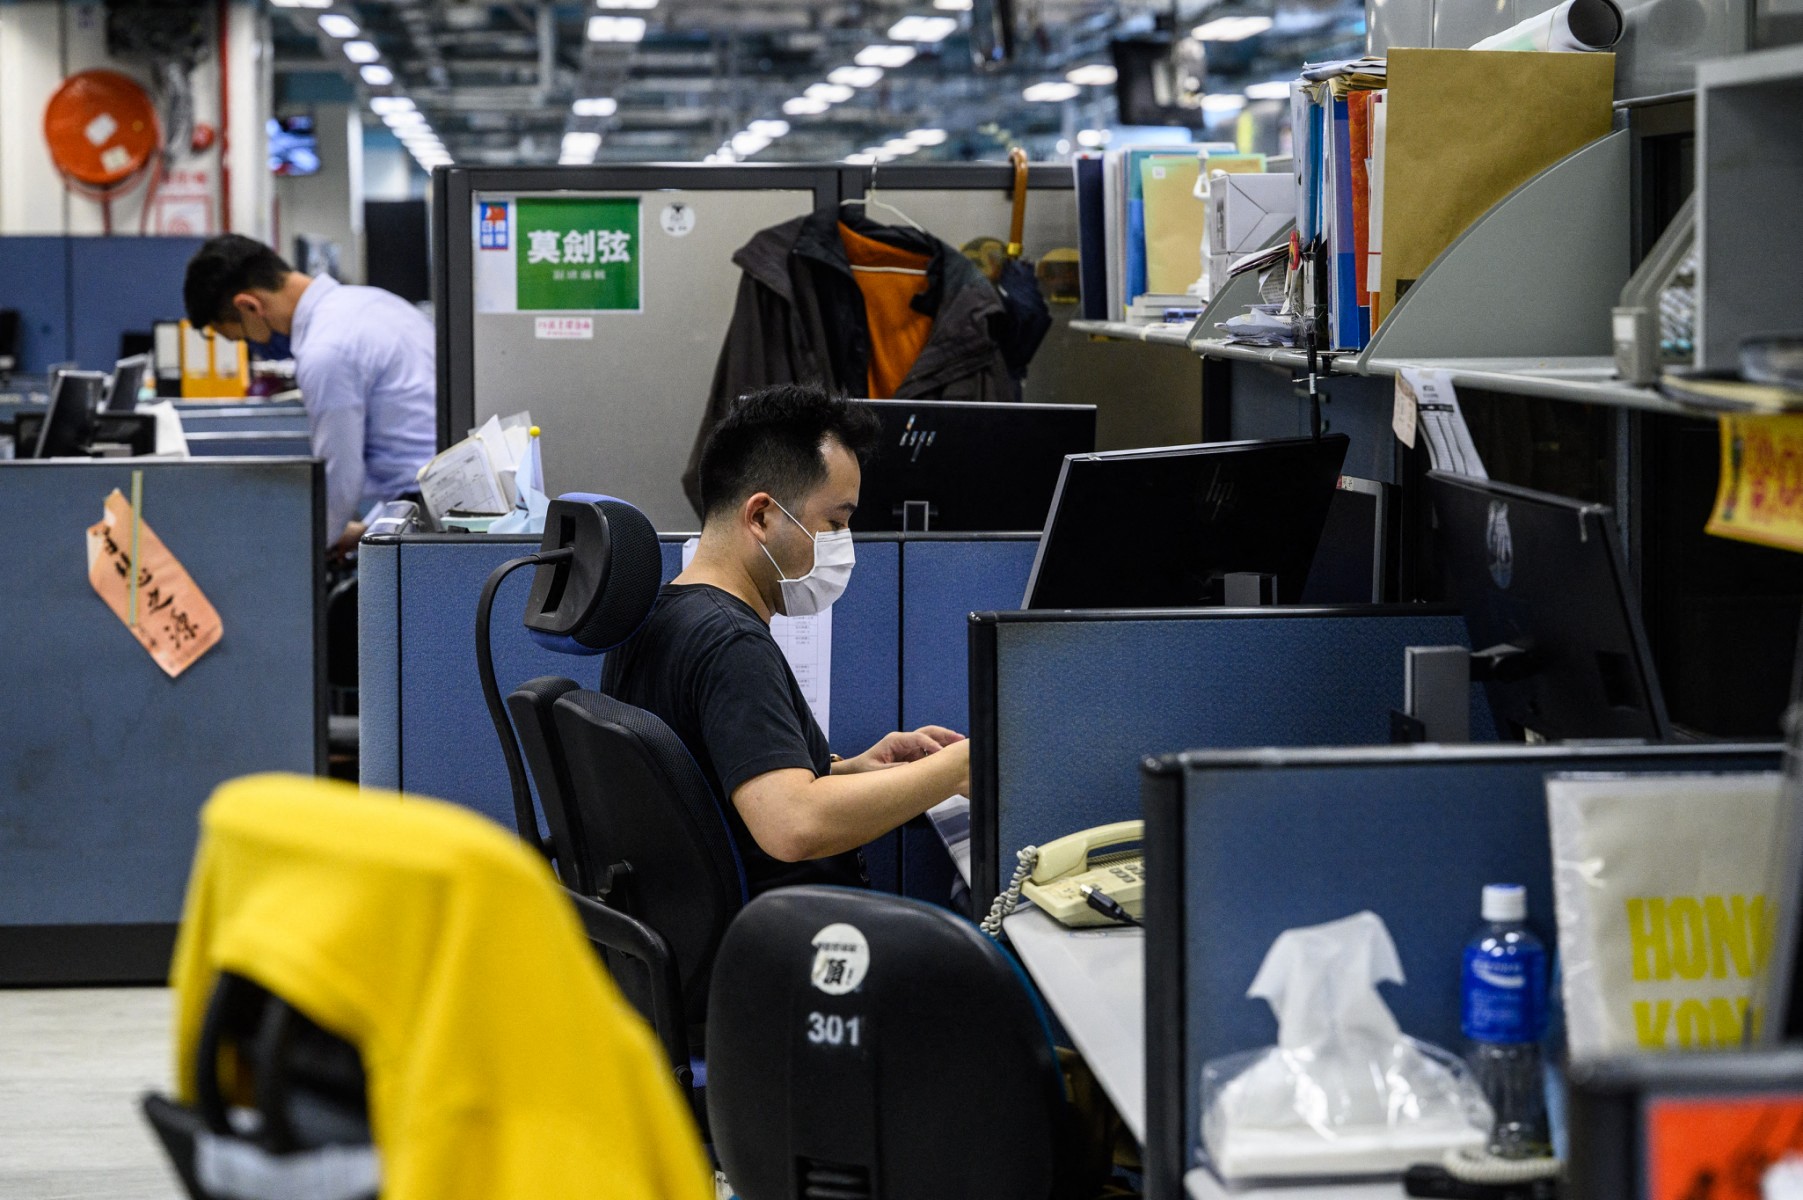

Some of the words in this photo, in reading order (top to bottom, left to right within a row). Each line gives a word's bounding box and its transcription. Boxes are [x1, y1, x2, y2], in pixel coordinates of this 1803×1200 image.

[527, 229, 631, 264] 莫劍弦
[899, 414, 937, 462] hp
[808, 1011, 860, 1046] 301
[1633, 998, 1762, 1049] KON
